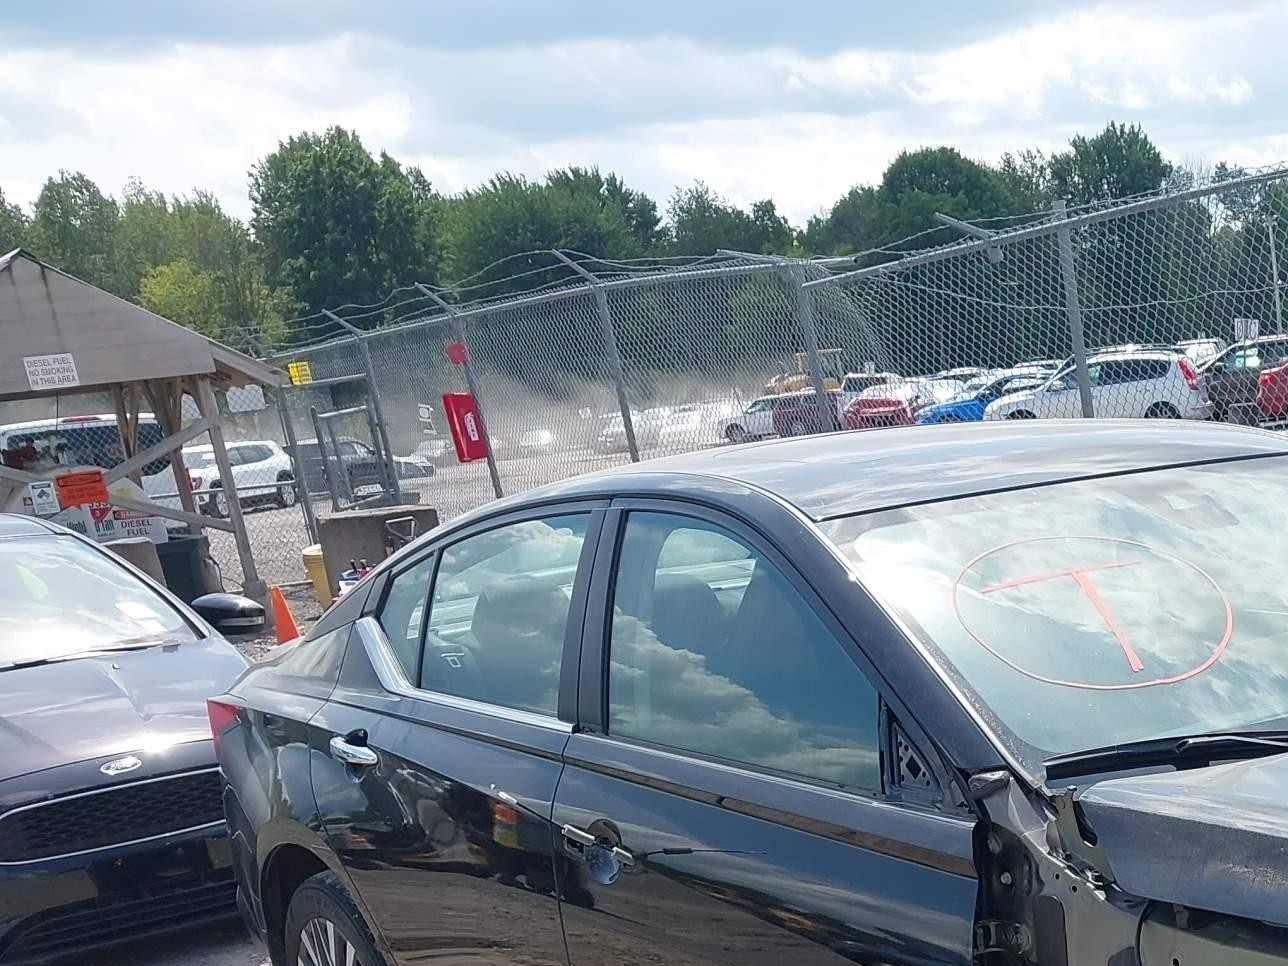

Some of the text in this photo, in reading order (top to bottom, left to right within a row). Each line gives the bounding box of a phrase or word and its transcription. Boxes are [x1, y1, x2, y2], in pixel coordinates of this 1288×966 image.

[26, 356, 73, 368] DIESEL FUEL
[28, 366, 73, 377] NO SMOKING
[39, 376, 57, 385] THIS
[57, 374, 78, 384] AREA
[120, 519, 152, 529] DIESEL
[127, 527, 150, 536] FUEL
[980, 559, 1145, 672] T
